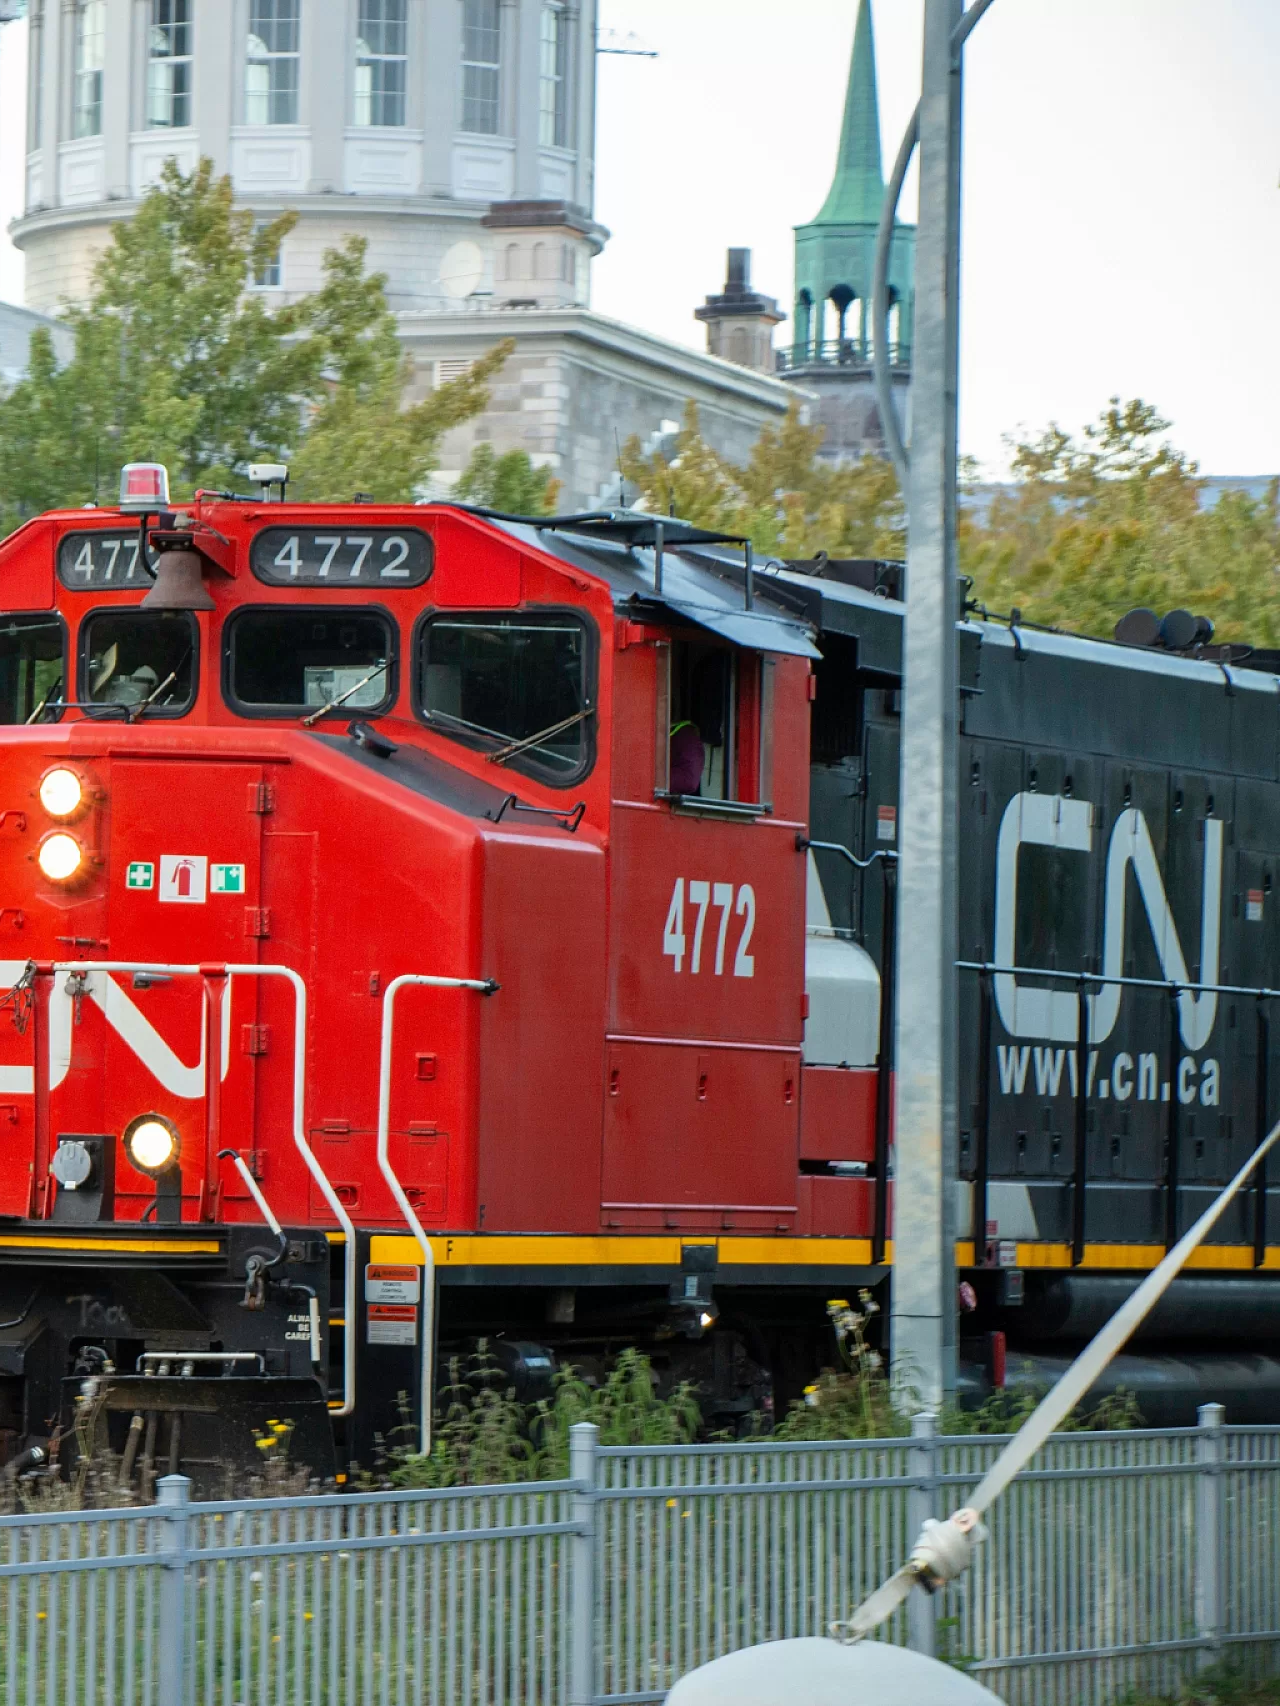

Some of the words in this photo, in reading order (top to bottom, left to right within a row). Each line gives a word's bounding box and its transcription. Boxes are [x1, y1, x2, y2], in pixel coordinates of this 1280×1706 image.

[274, 536, 410, 577] 4772
[663, 877, 755, 977] 4772
[994, 791, 1223, 1051] CN
[997, 1045, 1220, 1106] www.cn.ca
[446, 1240, 453, 1260] F
[284, 1331, 324, 1341] CAREFL
[287, 1314, 321, 1323] ALWA
